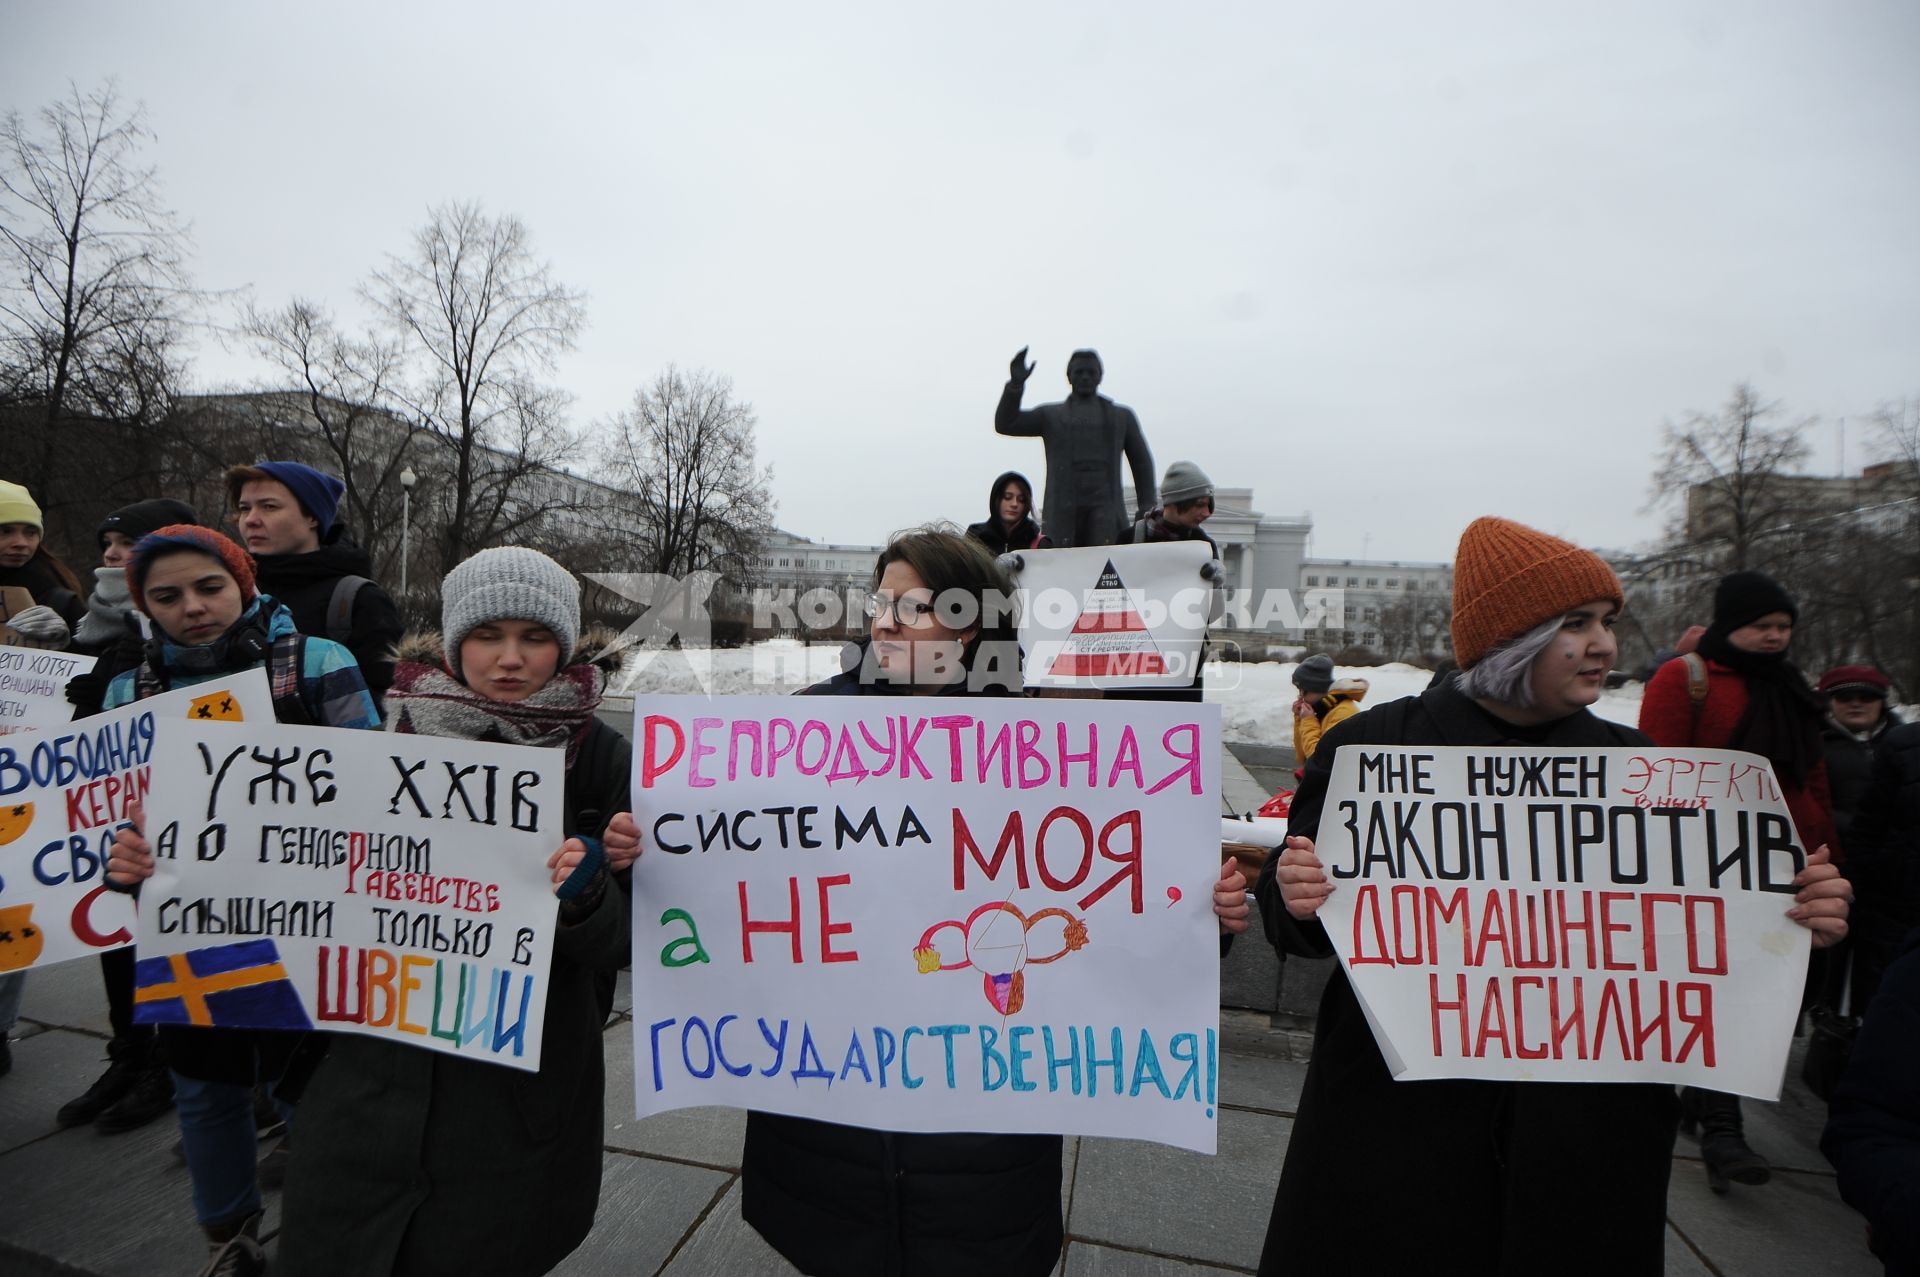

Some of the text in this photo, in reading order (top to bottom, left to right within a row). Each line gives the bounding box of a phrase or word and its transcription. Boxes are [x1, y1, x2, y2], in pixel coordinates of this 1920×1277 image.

[28, 655, 80, 677] ХОТЯТ
[197, 743, 338, 821] УЖЕ
[641, 714, 1204, 796] РЕПРОДУКТИВНАЯ
[1358, 752, 1436, 796] МНЕ
[1467, 755, 1607, 799] НУЖЕН
[157, 820, 432, 893] А О ГЕНДЕРНОМ
[653, 804, 1183, 914] СИСТЕМА МОЯ,
[1332, 800, 1808, 894] ЗАКОН ПРОТИВ
[158, 896, 335, 938] СЛЫШАЛИ
[372, 906, 494, 959] ТОЛЬКО
[737, 874, 859, 965] НЕ
[1348, 884, 1729, 976] ДОМАШНЕГО
[317, 945, 535, 1057] ШВЕЦИИ
[1429, 973, 1717, 1068] НАСИЛИЯ
[650, 1014, 1217, 1119] ГОСУДАРСТВЕННАЯ!
